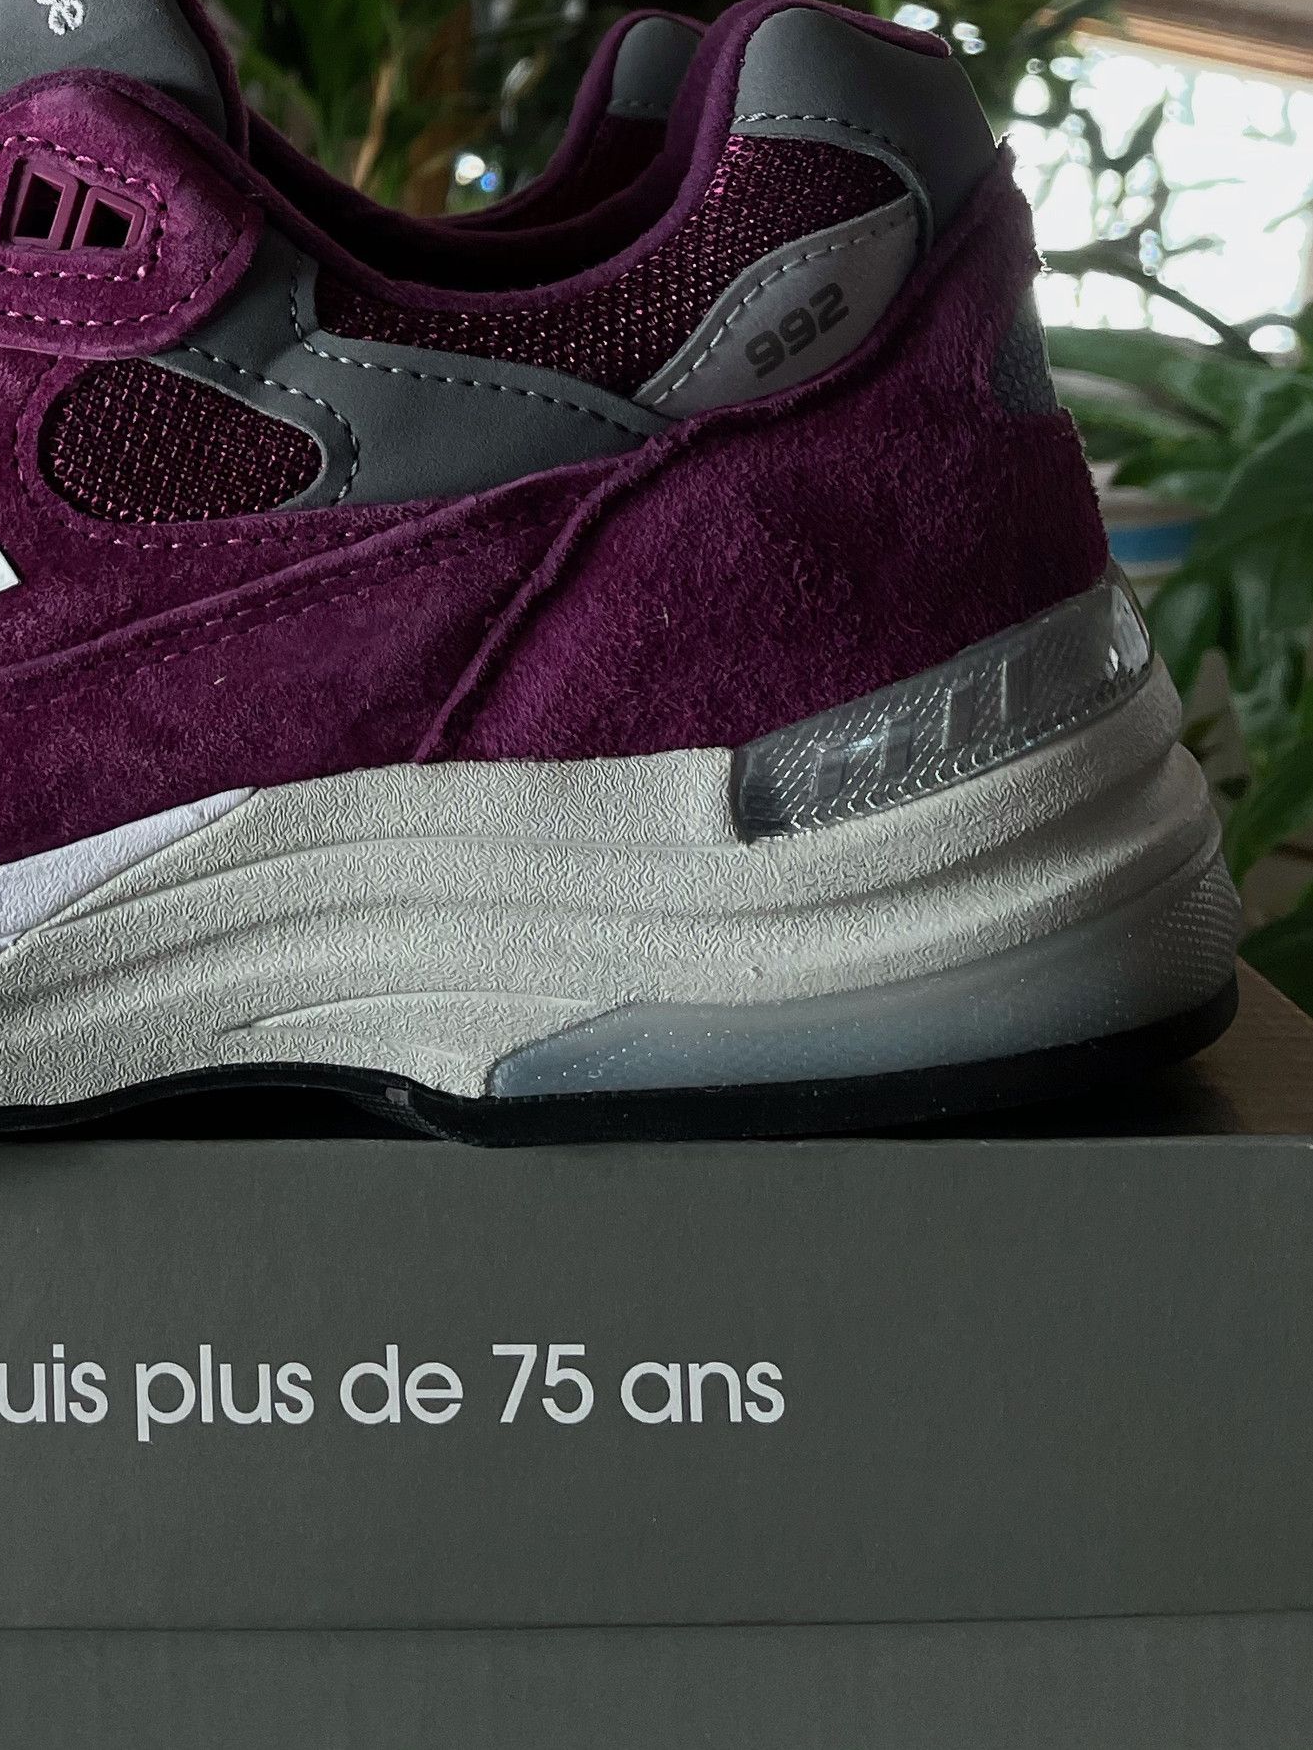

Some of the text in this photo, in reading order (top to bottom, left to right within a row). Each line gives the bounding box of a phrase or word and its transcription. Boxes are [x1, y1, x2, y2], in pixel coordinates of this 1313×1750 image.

[745, 282, 849, 379] 992
[136, 1344, 314, 1442] plus
[340, 1344, 463, 1424] de
[492, 1344, 594, 1424] 75
[621, 1361, 784, 1424] ans
